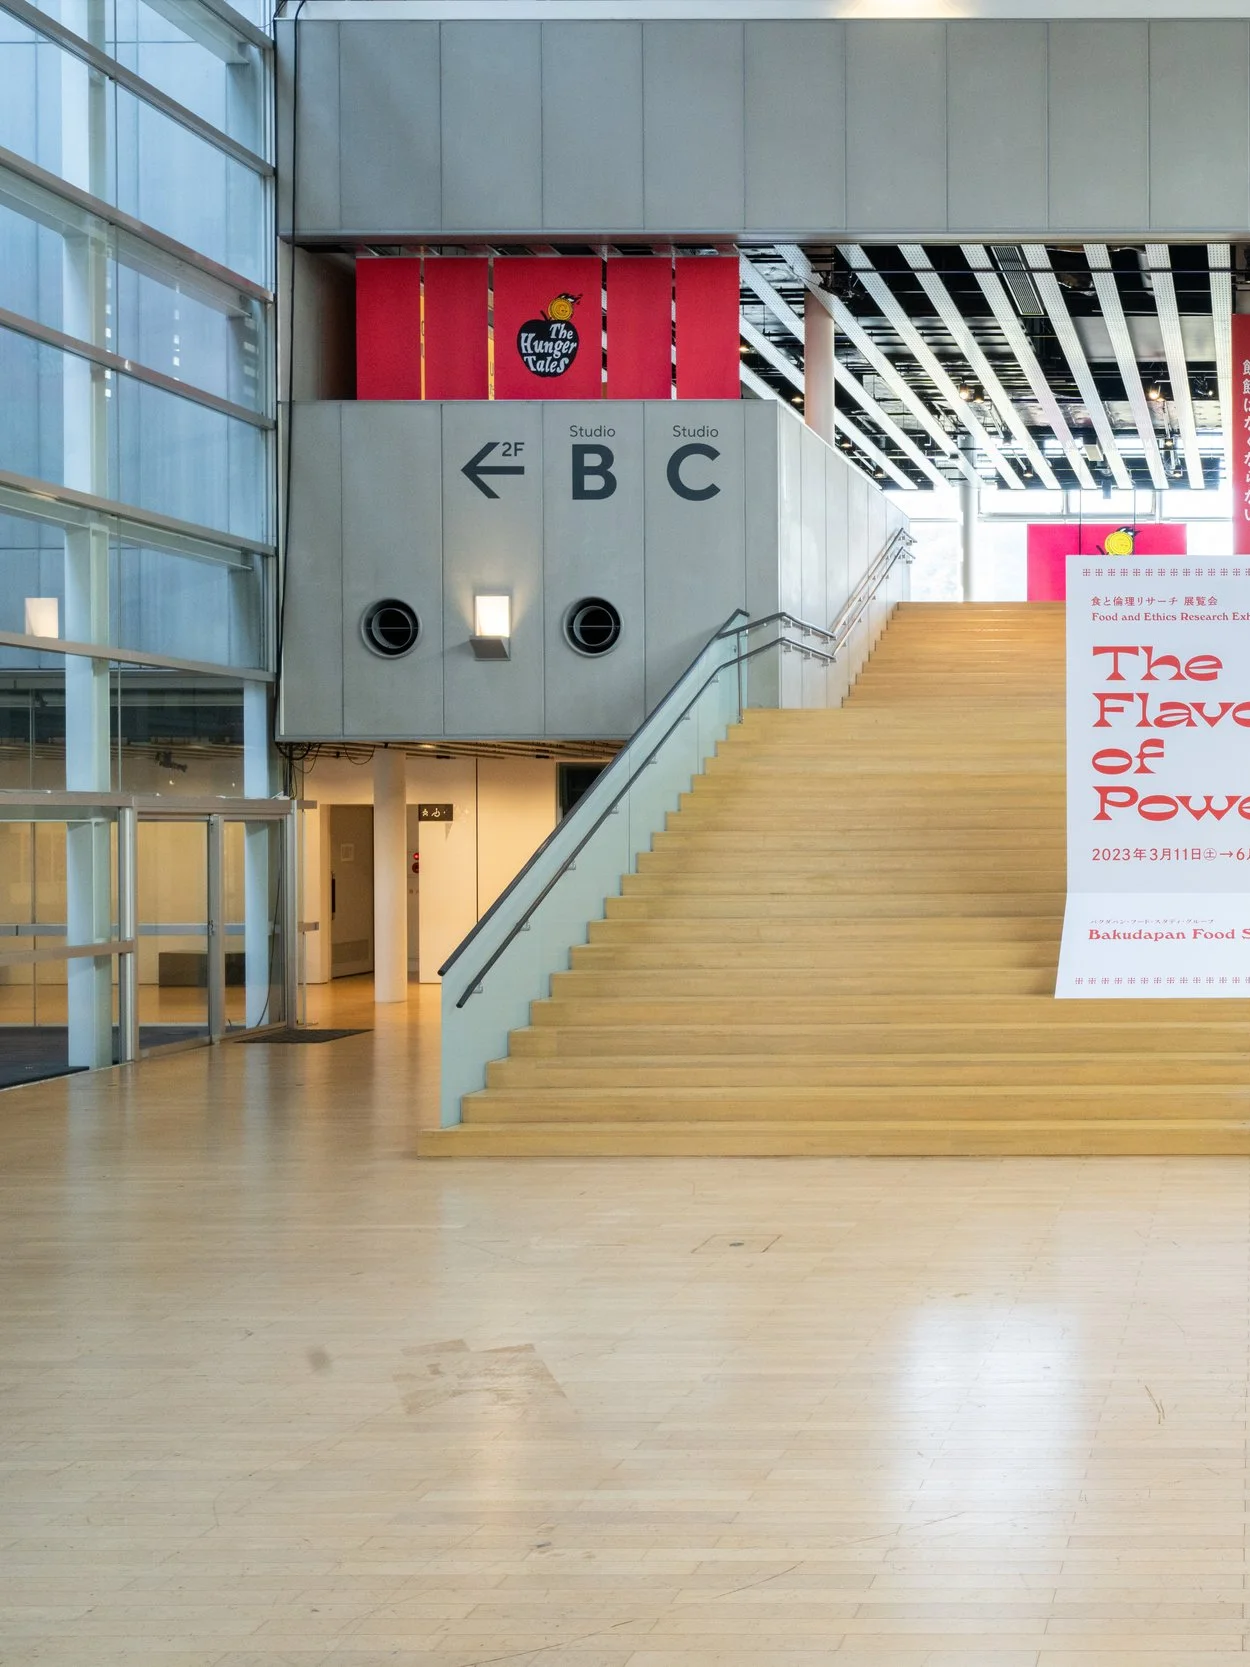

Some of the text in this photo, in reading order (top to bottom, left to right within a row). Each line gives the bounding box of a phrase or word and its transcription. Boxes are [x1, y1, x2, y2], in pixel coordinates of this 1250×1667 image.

[550, 324, 573, 339] The
[520, 333, 578, 359] Hunger
[523, 355, 570, 374] Tales
[569, 425, 616, 438] Studio
[672, 425, 719, 438] Studio
[501, 442, 525, 457] 2F
[571, 443, 618, 501] B
[666, 442, 721, 502] C
[1091, 596, 1218, 607] 食と倫理リサーチ 展覧会
[1091, 612, 1118, 622] Food
[1121, 612, 1141, 622] and
[1144, 612, 1177, 622] Ethics
[1180, 612, 1229, 621] Research
[1092, 645, 1223, 682] The
[1091, 737, 1165, 775] of
[1088, 928, 1186, 942] Bakudapan
[1192, 928, 1236, 940] Food
